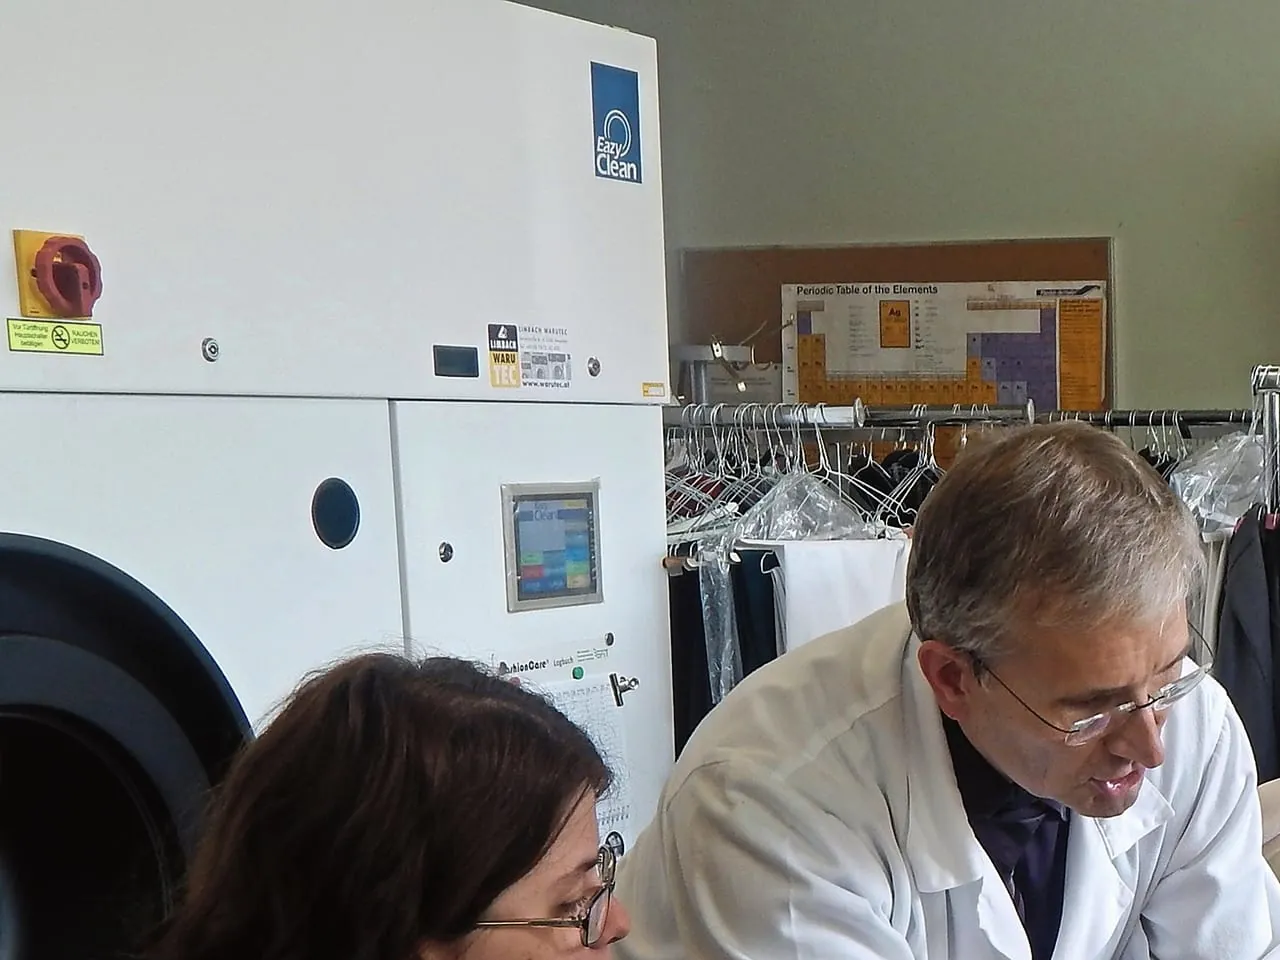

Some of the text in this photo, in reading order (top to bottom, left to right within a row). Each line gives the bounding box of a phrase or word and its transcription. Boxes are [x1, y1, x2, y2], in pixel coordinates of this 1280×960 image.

[597, 136, 622, 160] Eazy
[596, 153, 637, 180] Clean
[796, 285, 938, 296] Periodic Table of the Elements
[490, 339, 517, 349] LIMBACH
[493, 353, 516, 364] WARU
[493, 365, 517, 385] TEC
